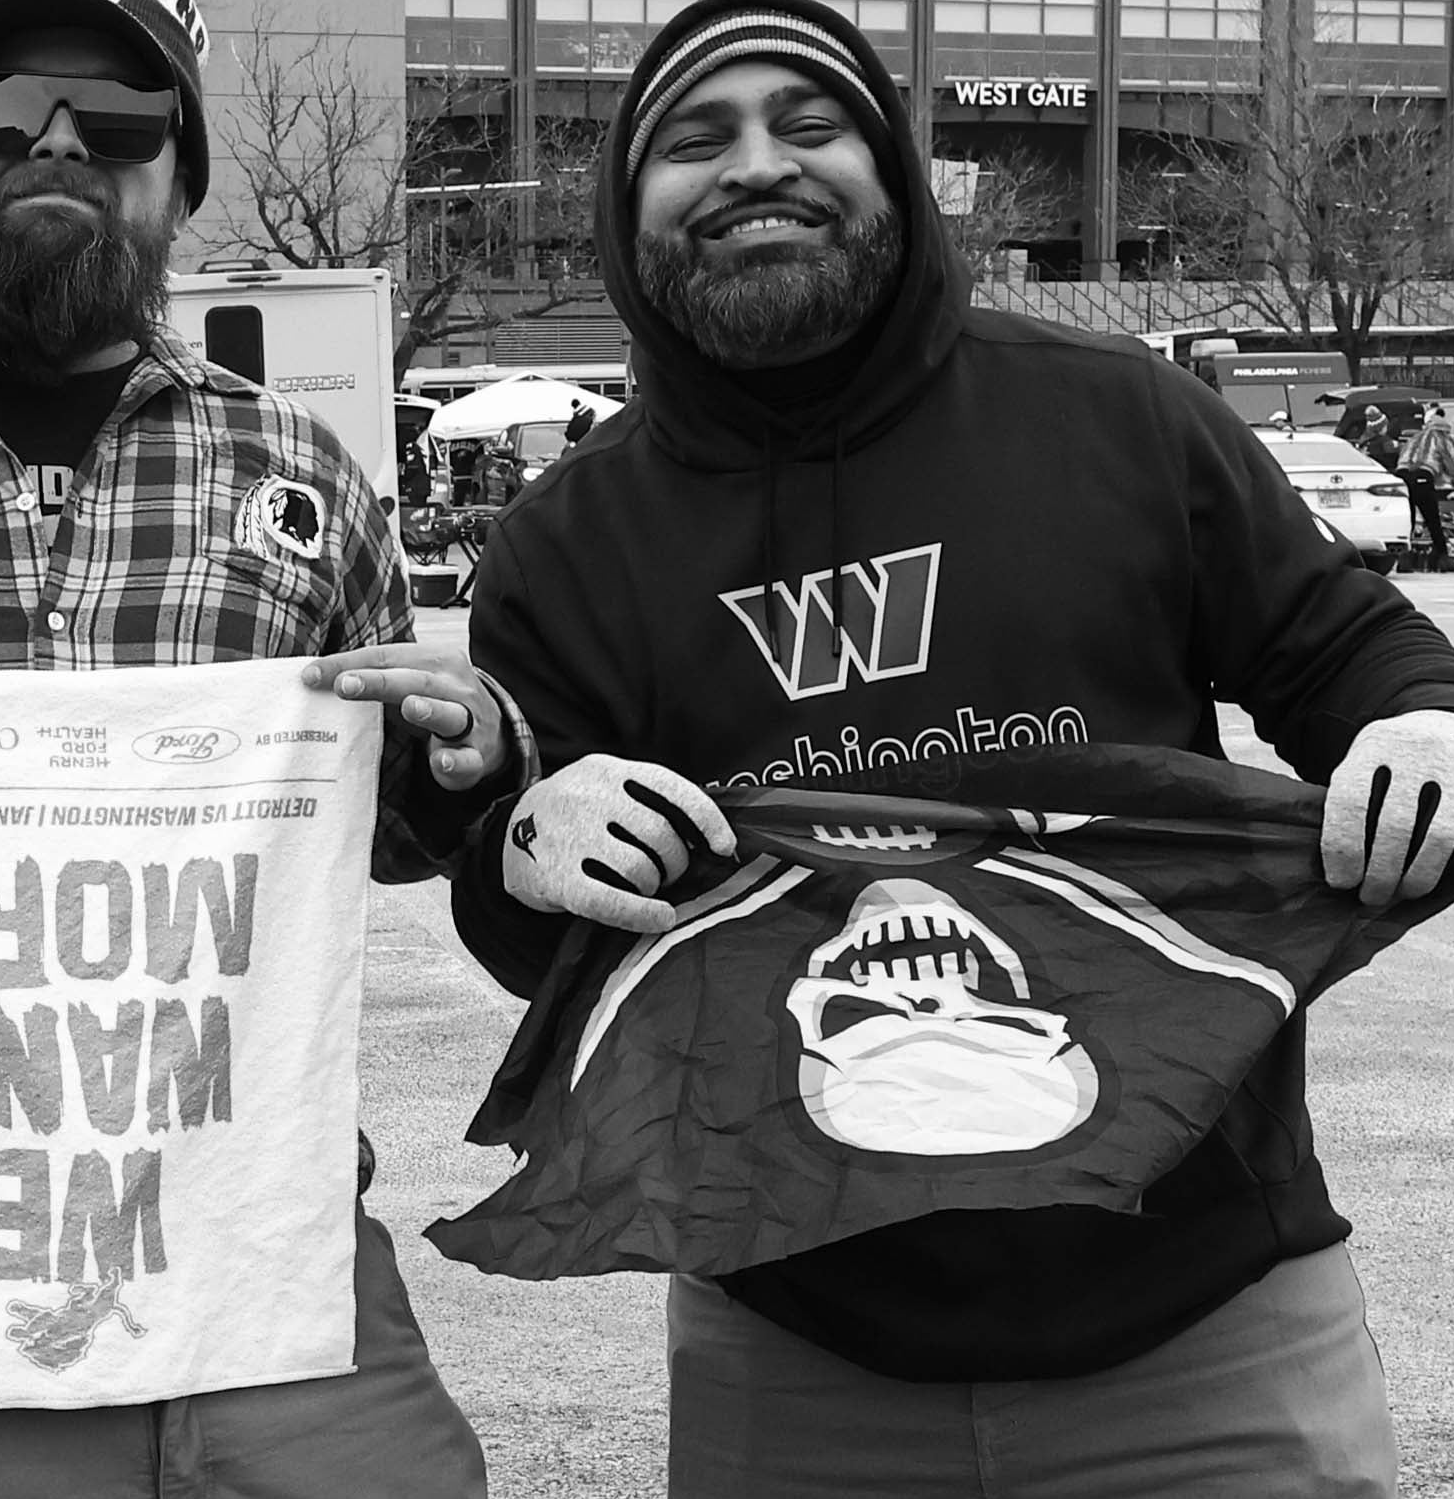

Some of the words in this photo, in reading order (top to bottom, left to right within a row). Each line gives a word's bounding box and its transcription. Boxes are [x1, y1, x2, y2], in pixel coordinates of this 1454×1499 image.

[955, 81, 1022, 106] WEST
[1028, 83, 1087, 107] GATE
[1233, 368, 1298, 376] PHILADELPHIA
[274, 373, 355, 392] ORION
[36, 725, 108, 740] HEALTH
[255, 732, 272, 747] BY
[274, 729, 339, 748] PRESENTED
[61, 740, 108, 753] FORD
[154, 732, 221, 761] Ford
[49, 755, 110, 768] HENRY
[51, 805, 197, 828] WASHINGTON
[201, 803, 227, 824] VS
[231, 794, 319, 822] DETROIT
